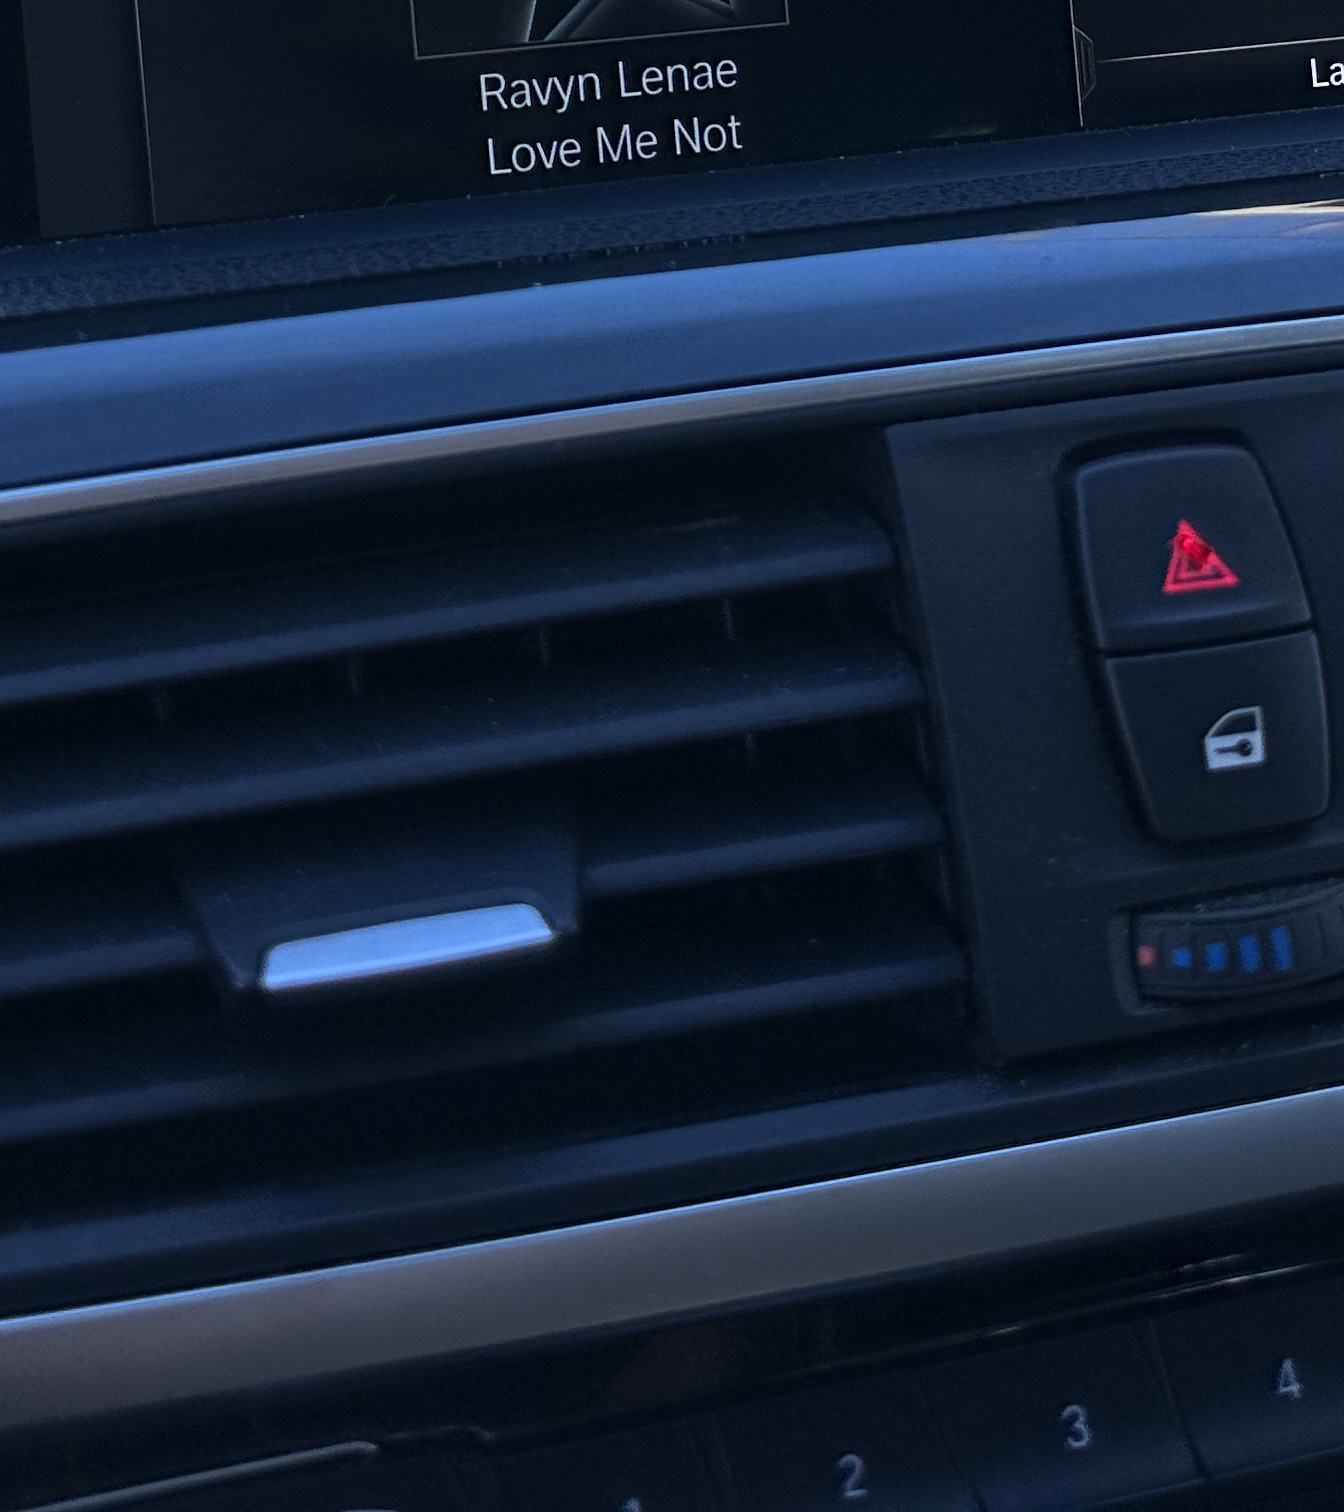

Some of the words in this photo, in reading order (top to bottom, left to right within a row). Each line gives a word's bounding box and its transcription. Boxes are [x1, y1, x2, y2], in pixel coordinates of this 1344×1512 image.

[479, 72, 602, 114] Ravyn
[618, 59, 738, 98] Lenae
[487, 137, 582, 175] Love
[596, 123, 658, 164] Me
[673, 114, 743, 155] Not
[1277, 1359, 1302, 1399] 4
[1061, 1404, 1093, 1449] 3
[838, 1453, 868, 1498] 2
